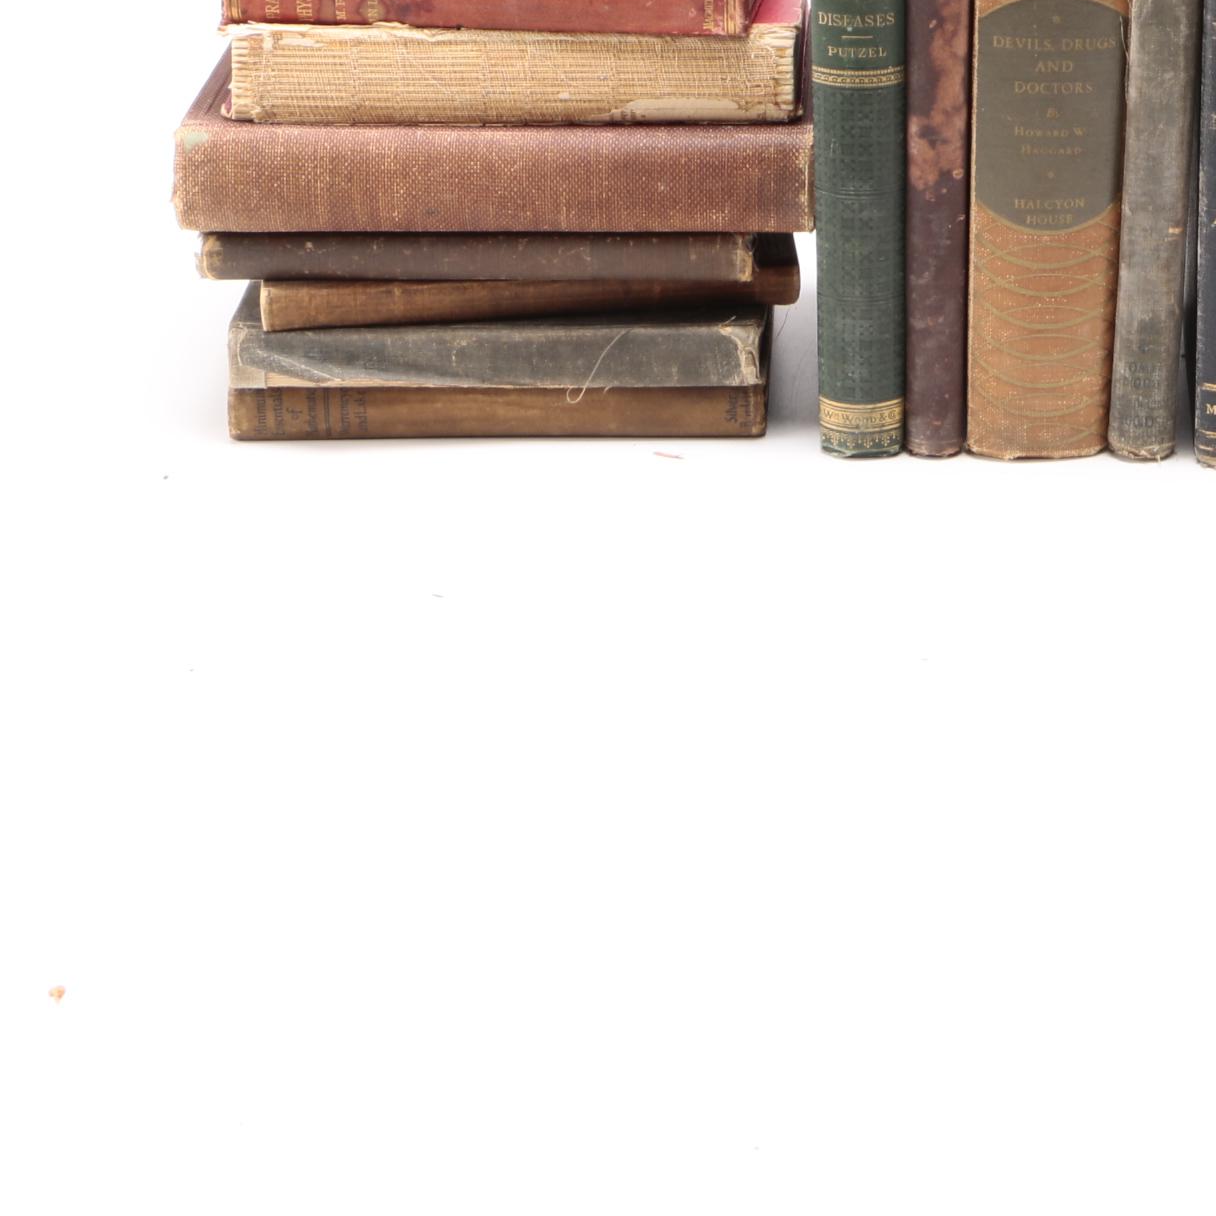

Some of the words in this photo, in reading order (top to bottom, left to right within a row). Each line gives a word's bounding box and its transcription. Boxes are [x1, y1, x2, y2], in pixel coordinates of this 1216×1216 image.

[817, 11, 896, 28] DISEASES
[1062, 36, 1117, 52] DRUGS
[827, 45, 888, 59] PUTZEL
[1034, 60, 1073, 73] AND
[1013, 80, 1094, 95] DOCTORS
[1014, 197, 1086, 211] HALCYON
[1025, 214, 1074, 227] HOUSE
